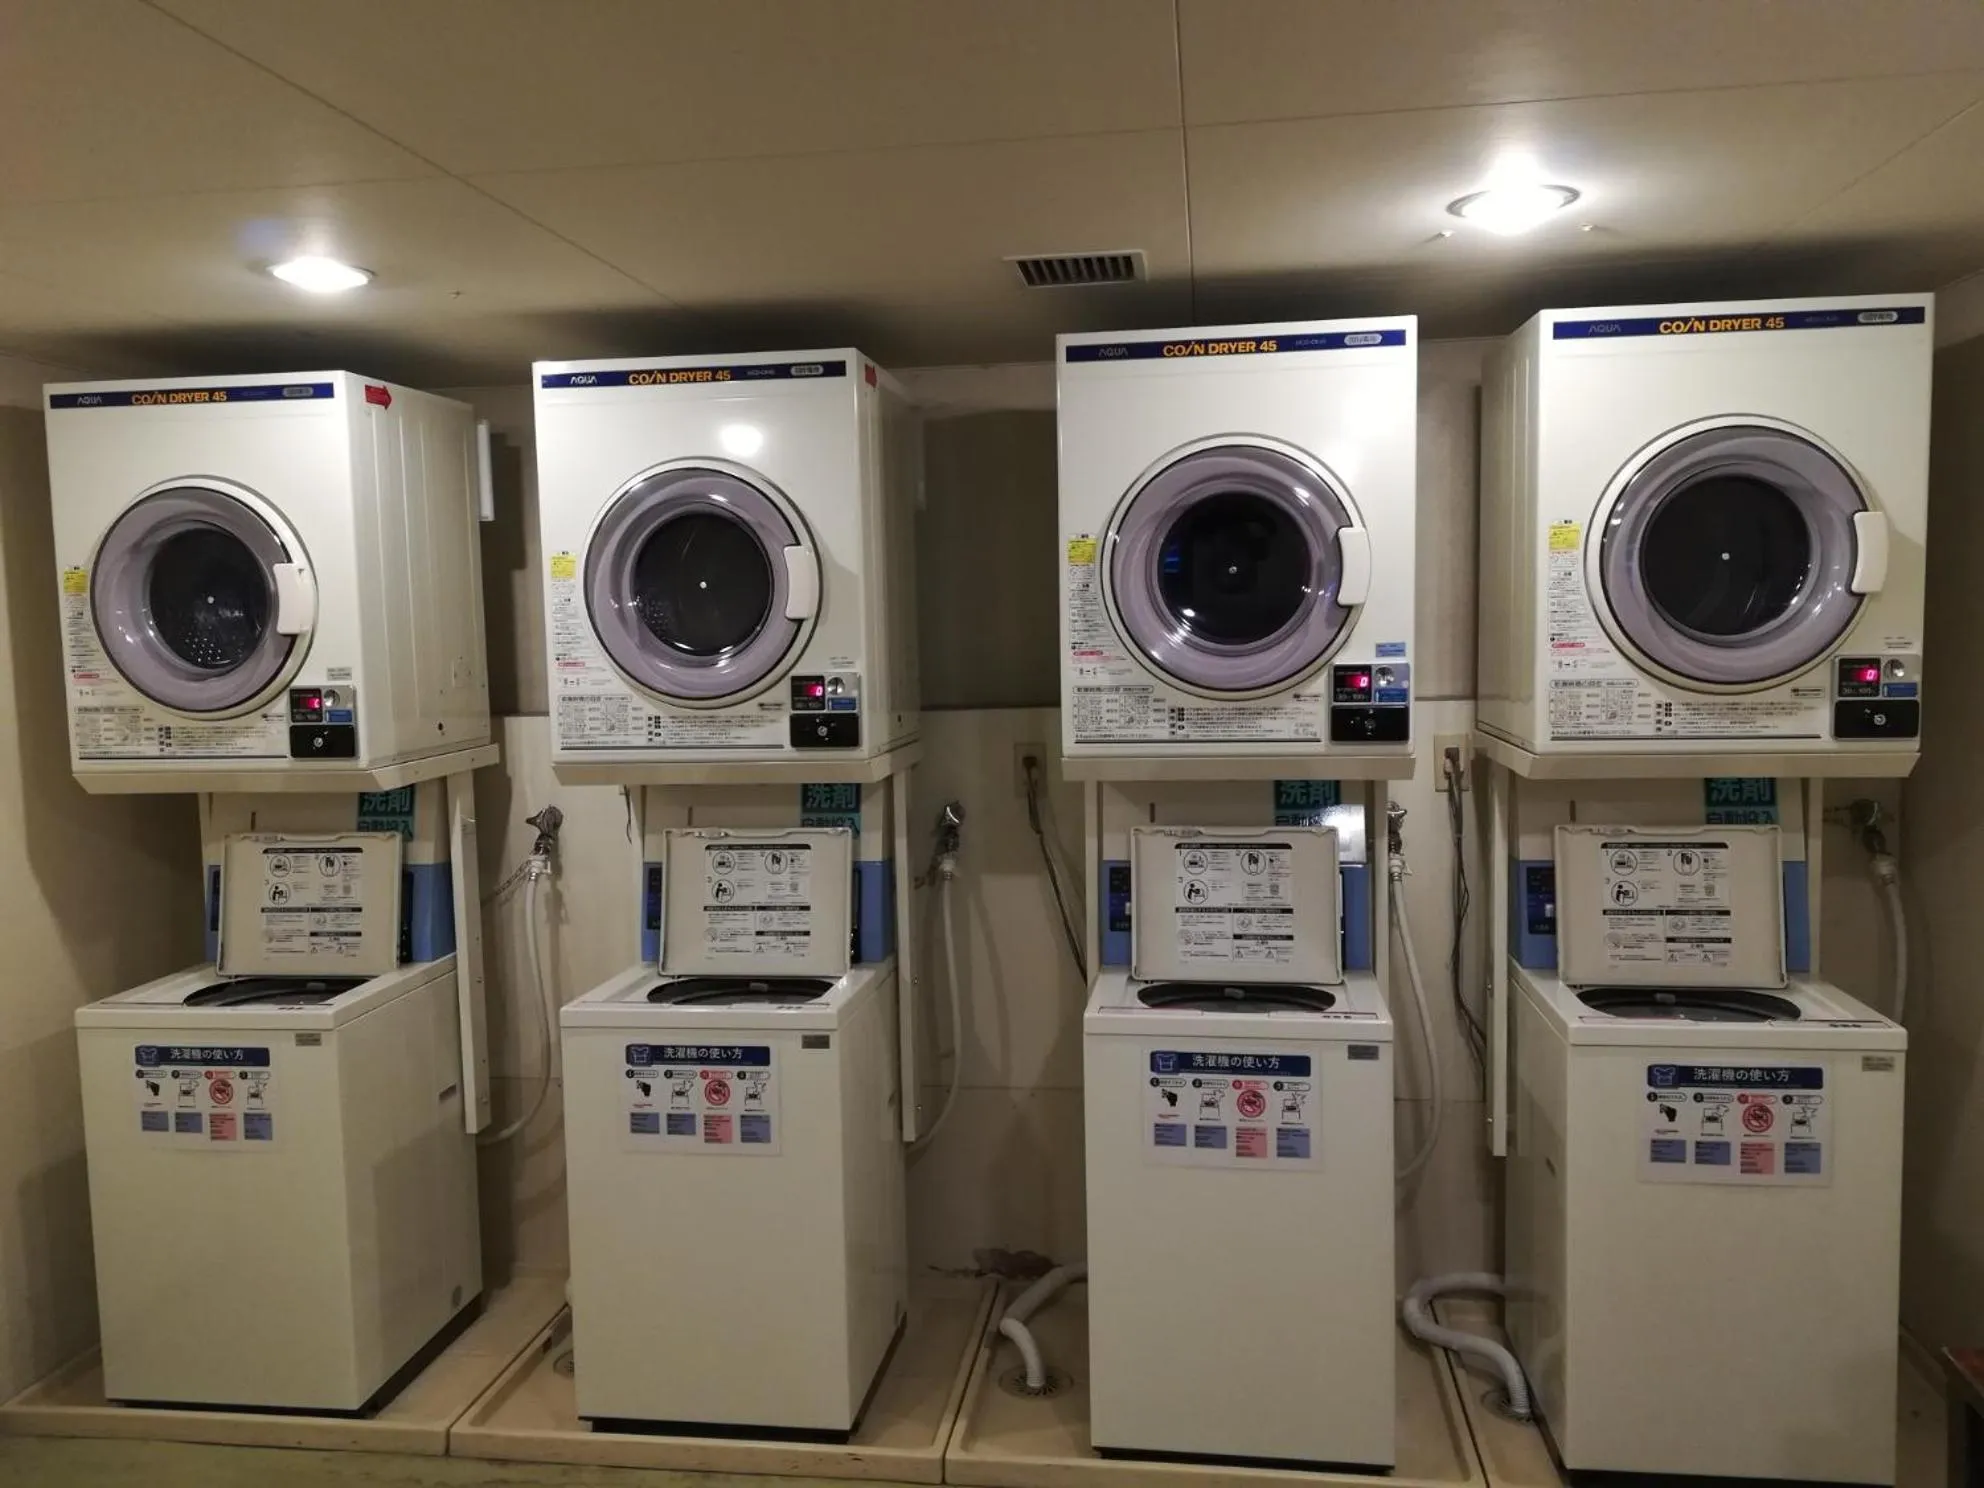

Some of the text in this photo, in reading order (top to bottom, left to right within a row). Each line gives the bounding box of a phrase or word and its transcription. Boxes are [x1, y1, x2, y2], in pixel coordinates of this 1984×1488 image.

[1588, 324, 1621, 335] AQUA
[1709, 318, 1762, 331] DRYER
[1766, 317, 1785, 329] 45
[1099, 347, 1129, 357] AQUA
[1208, 341, 1256, 354] DRYER
[1259, 340, 1277, 352] 45
[570, 375, 597, 385] AQUA
[669, 371, 712, 383] DRYER
[715, 370, 731, 380] 45
[169, 392, 209, 403] DRYER
[213, 391, 227, 402] 45
[806, 784, 857, 809] 洗剤
[1280, 780, 1336, 804] 洗剤
[1710, 778, 1772, 803] 洗剤
[362, 789, 411, 812] 洗剤
[664, 1046, 743, 1060] 洗濯機の使い方
[1192, 1054, 1281, 1069] 洗濯機の使い方
[1693, 1067, 1793, 1083] 洗濯機の使い方
